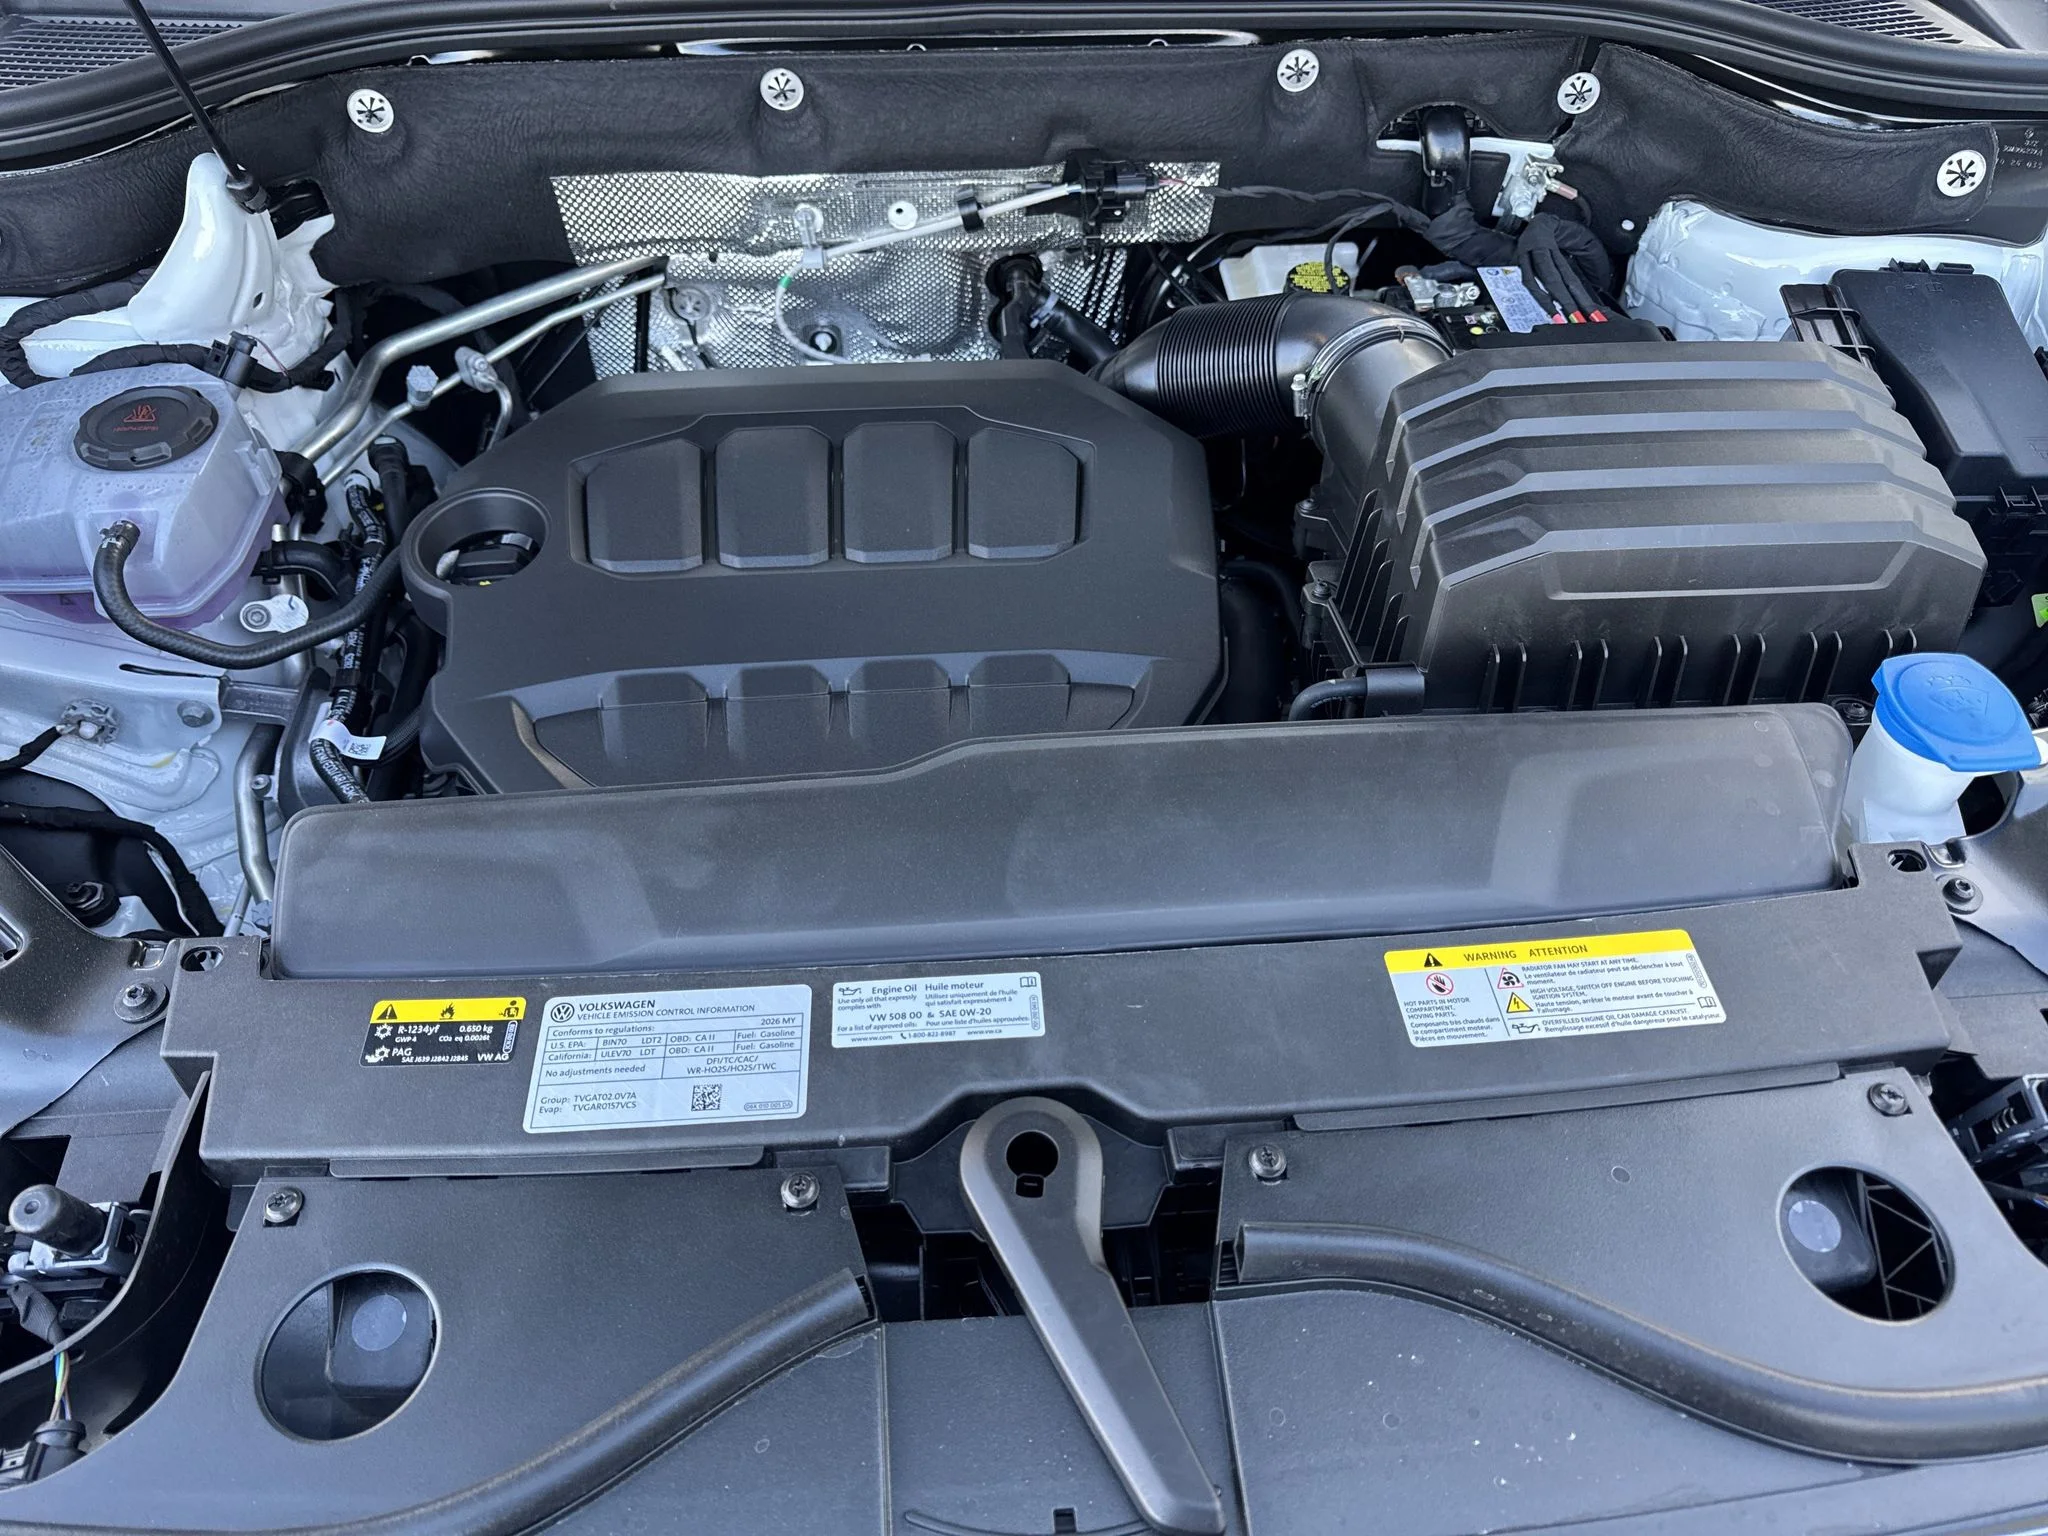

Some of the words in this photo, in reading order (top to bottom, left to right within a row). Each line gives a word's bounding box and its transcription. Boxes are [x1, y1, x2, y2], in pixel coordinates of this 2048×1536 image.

[1530, 945, 1587, 956] ATTENTION
[1464, 950, 1516, 961] WARNING
[872, 986, 902, 995] Engine
[904, 984, 917, 992] Oil
[925, 983, 949, 991] Huile
[580, 1000, 655, 1011] VOLKSWAGEN
[1406, 1005, 1455, 1013] COMPARTMENT.
[577, 1012, 610, 1020] VEHICLE
[613, 1010, 653, 1018] EMISSION
[656, 1008, 694, 1016] CONTROL
[697, 1005, 755, 1014] INFORMATION
[869, 1014, 886, 1022] VW
[889, 1012, 906, 1021] 508
[909, 1011, 922, 1019] 00
[959, 1008, 991, 1016] 0W-20
[873, 1022, 903, 1030] approved
[1542, 1018, 1580, 1026] OVERFILLED
[398, 1025, 440, 1035] R-1234yf
[483, 1024, 493, 1034] kg
[553, 1029, 592, 1037] Conforms
[606, 1025, 654, 1035] regulations:
[670, 1035, 691, 1043] OBD:
[695, 1034, 707, 1042] CA
[737, 1031, 756, 1039] Fuel:
[760, 1030, 795, 1038] Gasoline
[603, 1038, 627, 1046] BIN70
[642, 1036, 662, 1044] LDT2
[759, 1041, 794, 1049] Gasoline
[392, 1048, 412, 1056] PAG
[601, 1050, 632, 1058] ULEV70
[640, 1048, 656, 1056] LDT
[478, 1053, 493, 1061] VW
[548, 1053, 591, 1061] California:
[707, 1056, 758, 1065] DFI/TC/CAC/
[560, 1067, 612, 1077] adjustments
[614, 1064, 646, 1073] needed
[687, 1063, 776, 1074] WR-HO2S/HO2S/TWC
[541, 1097, 570, 1105] Group:
[575, 1092, 636, 1102] TVGAT02.0V7A
[539, 1106, 562, 1114] Evap:
[573, 1101, 636, 1111] TVGAR0157VCS
